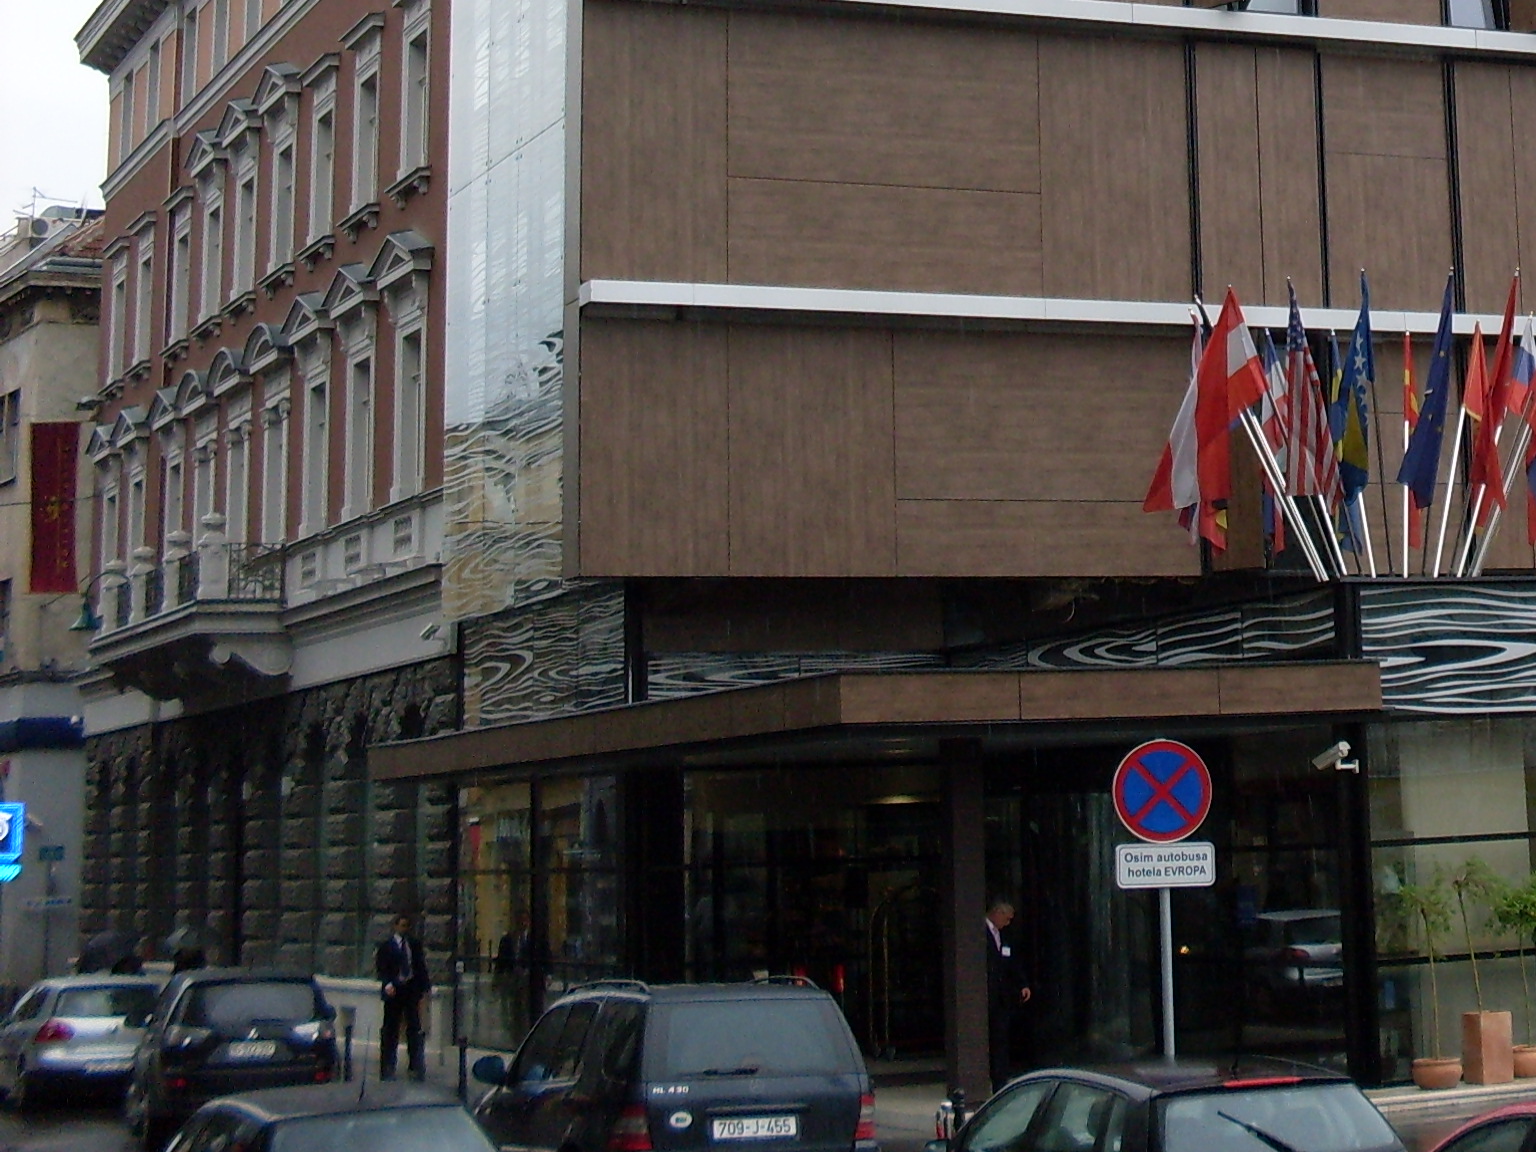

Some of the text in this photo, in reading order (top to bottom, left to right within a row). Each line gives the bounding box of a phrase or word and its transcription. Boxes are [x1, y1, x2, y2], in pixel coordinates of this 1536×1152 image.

[1124, 850, 1208, 863] Osim autobusa
[1127, 864, 1207, 878] hotela EVROPA
[718, 1119, 792, 1137] 709-J-455
